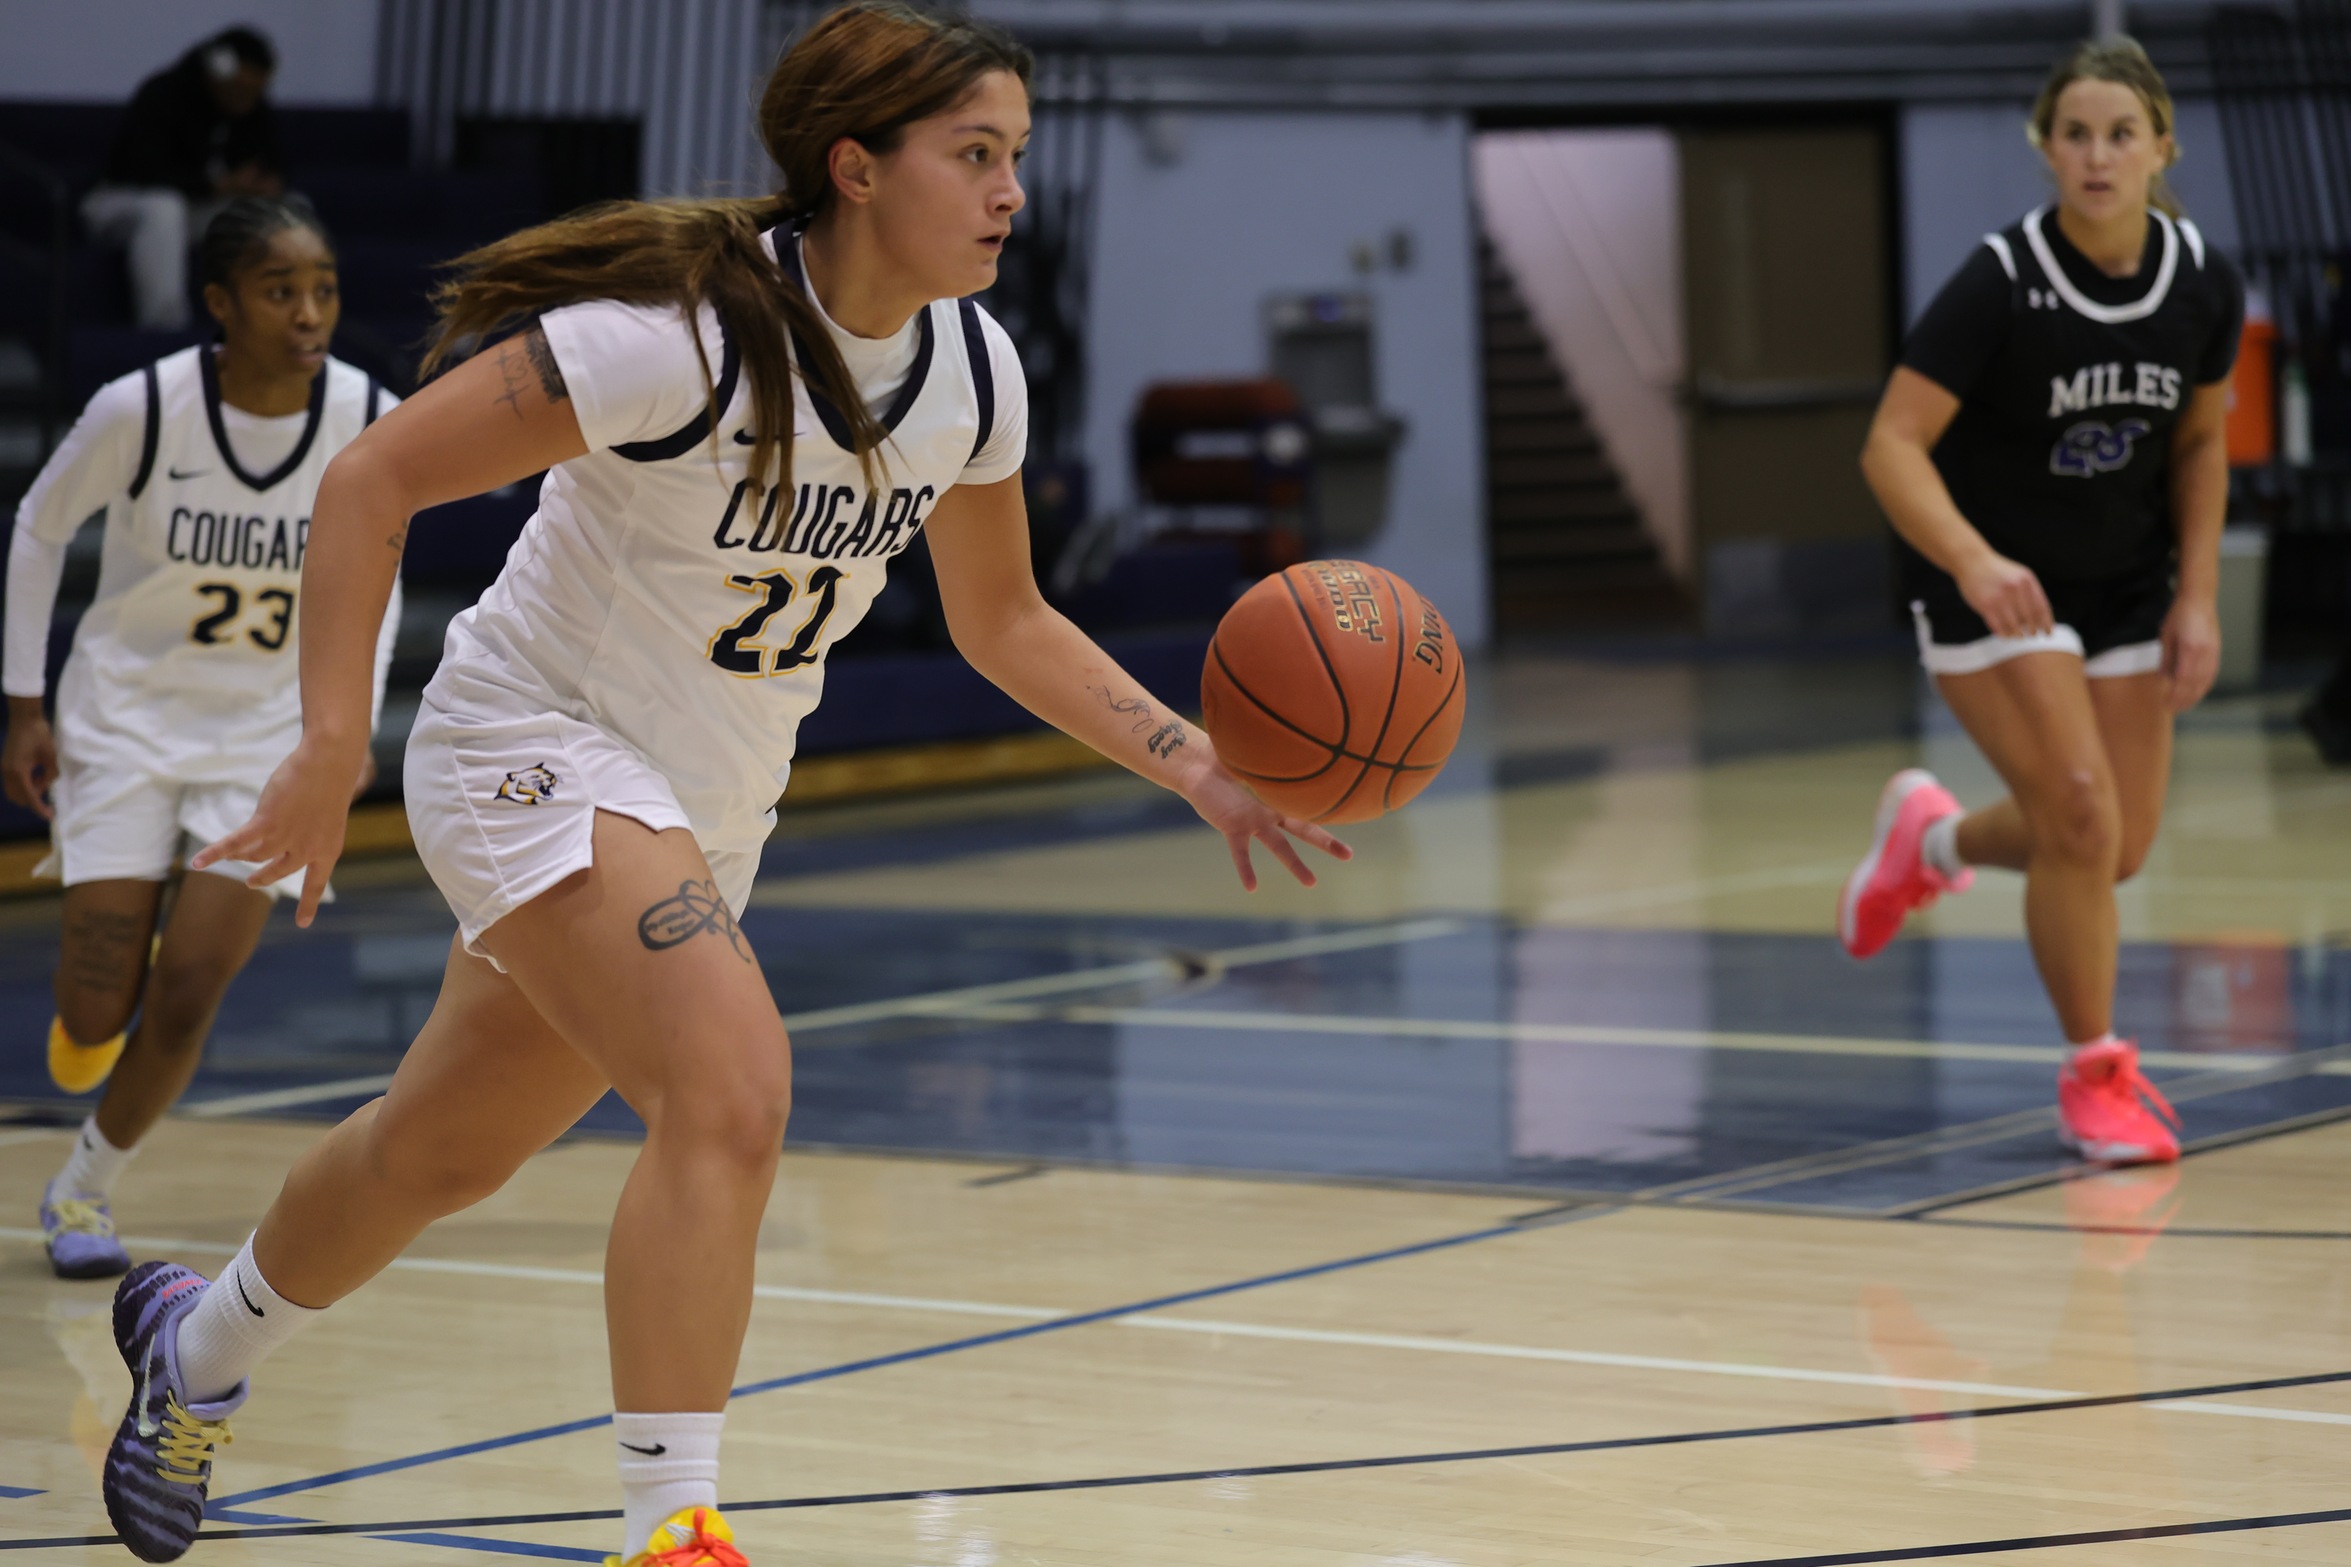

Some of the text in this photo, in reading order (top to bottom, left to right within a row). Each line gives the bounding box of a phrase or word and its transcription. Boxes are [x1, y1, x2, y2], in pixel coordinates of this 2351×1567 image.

[2048, 362, 2182, 418] MILES
[167, 506, 311, 573] COUGAR
[713, 476, 935, 560] COUGARS
[188, 580, 298, 652] 23
[1330, 560, 1386, 644] EGACY
